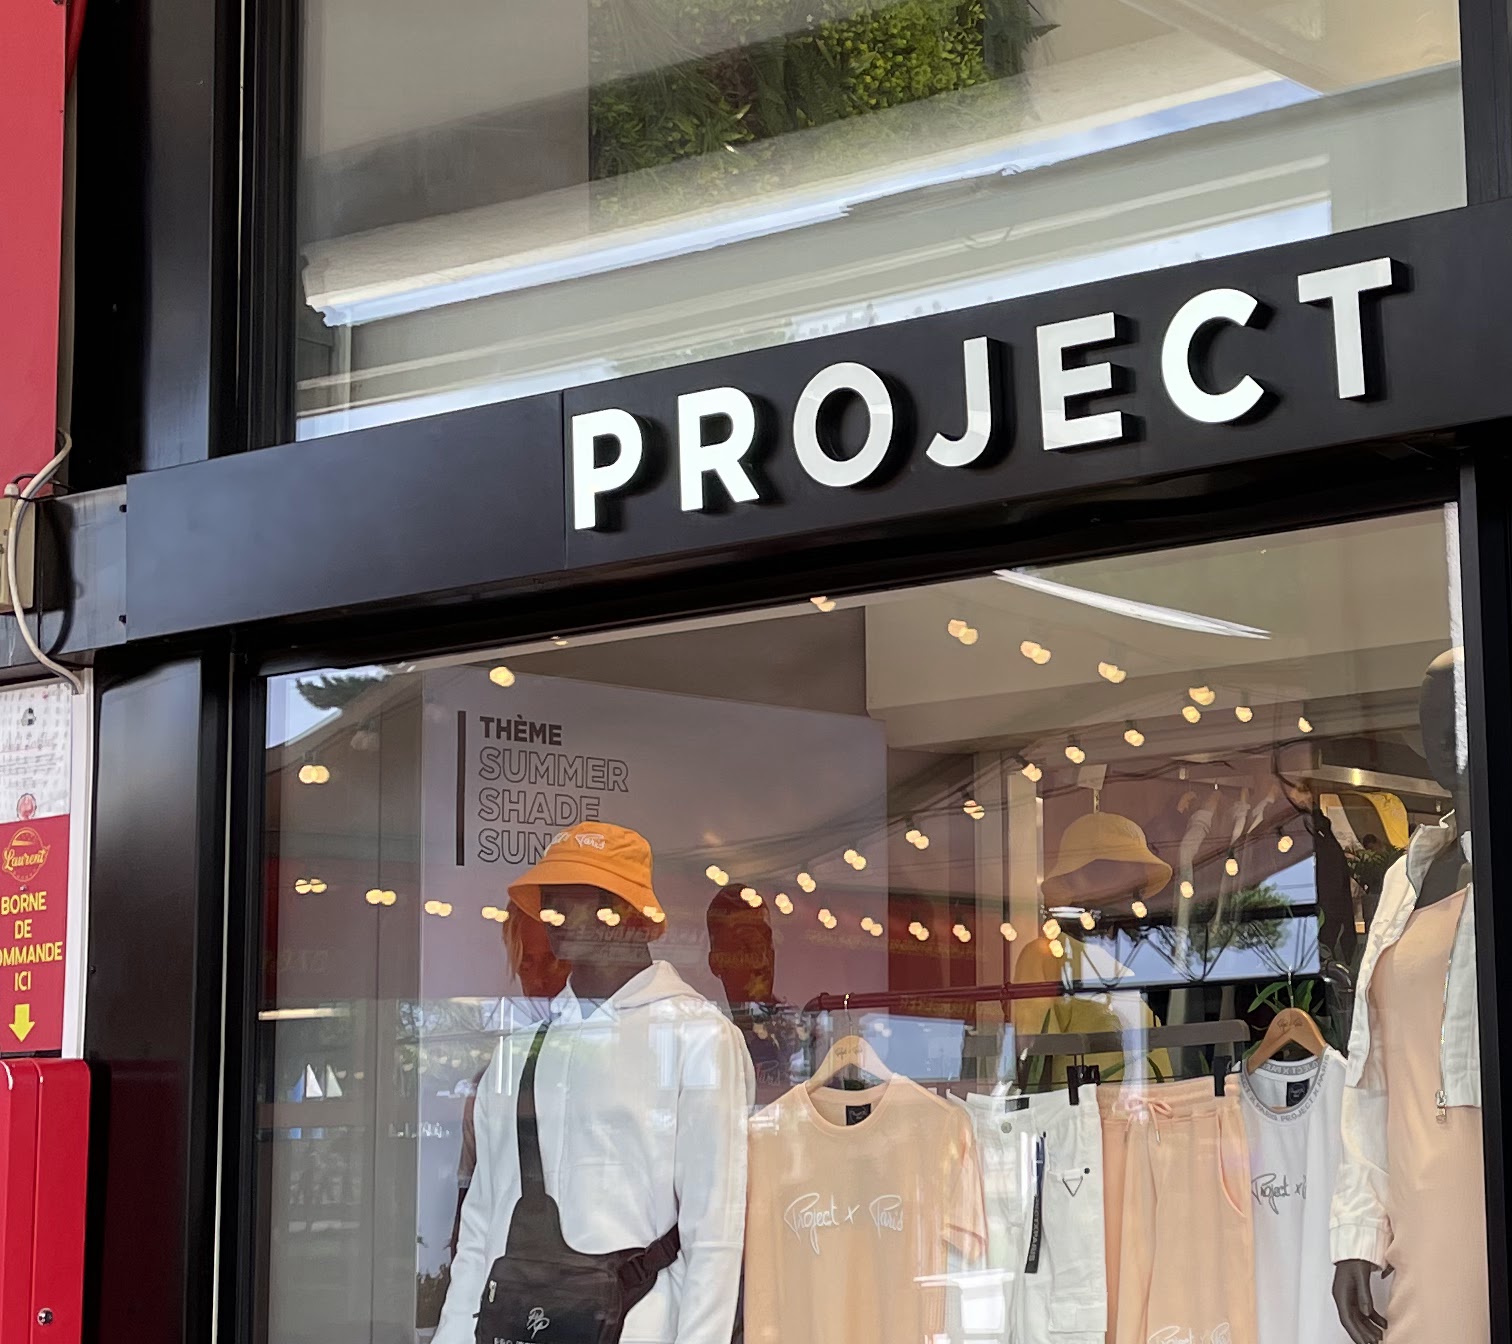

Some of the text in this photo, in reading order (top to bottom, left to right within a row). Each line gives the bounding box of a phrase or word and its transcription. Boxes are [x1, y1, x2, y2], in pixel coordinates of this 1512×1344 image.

[571, 254, 1396, 533] PROJECT
[479, 714, 563, 746] THÈME
[478, 745, 629, 793] SUMMER
[477, 786, 601, 827] SHADE
[3, 845, 50, 871] Laurent
[1, 890, 47, 915] BORNE
[14, 919, 32, 940] DE
[0, 941, 63, 967] MMANDE
[14, 970, 32, 991] ICI
